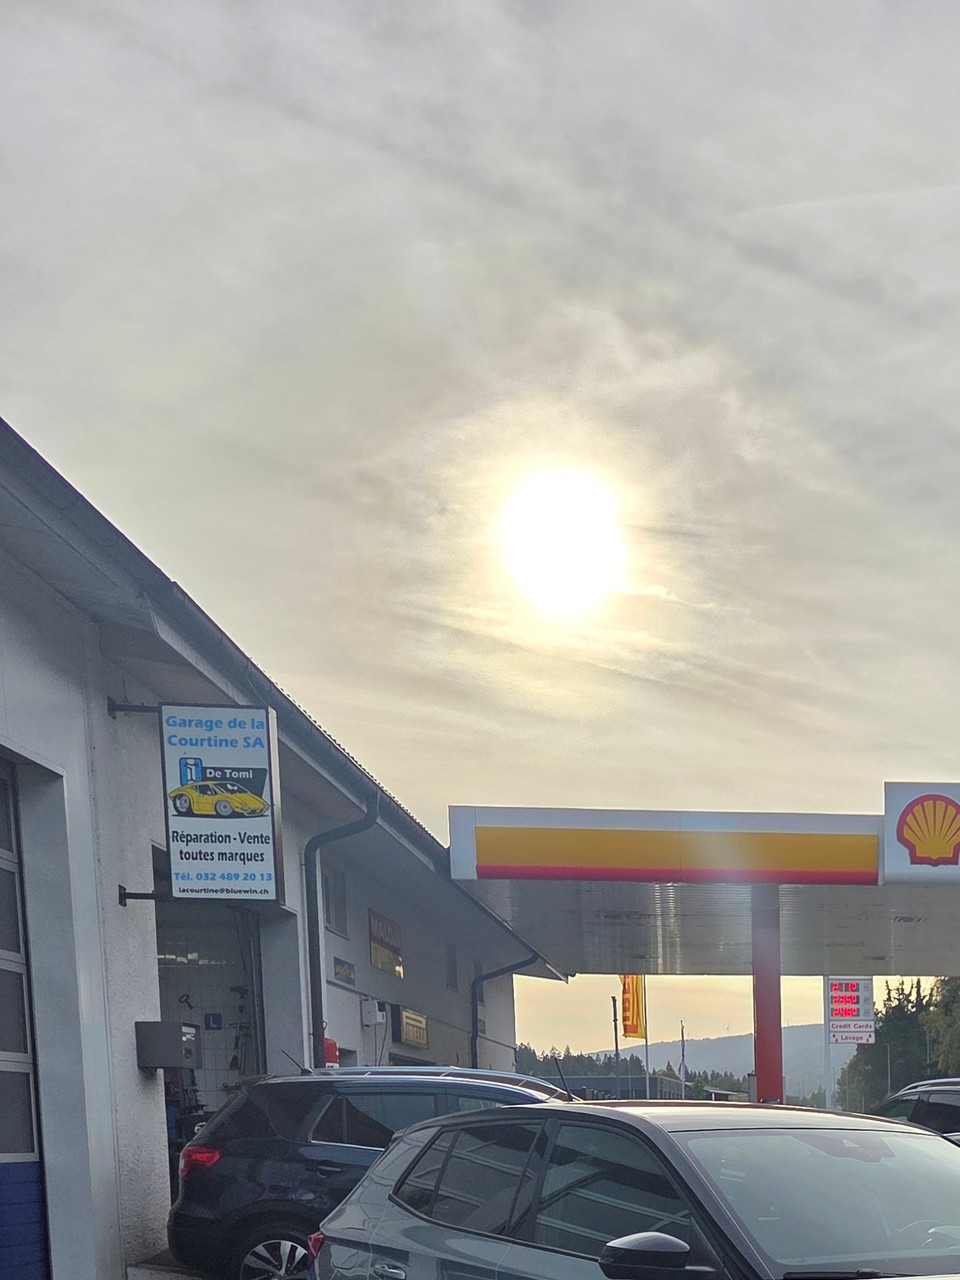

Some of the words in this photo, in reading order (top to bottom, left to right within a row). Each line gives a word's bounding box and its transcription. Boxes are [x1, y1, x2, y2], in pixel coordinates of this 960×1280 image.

[165, 715, 224, 732] Garage
[227, 717, 247, 729] de
[250, 718, 265, 730] la
[167, 734, 239, 748] Courtine
[242, 736, 265, 748] SA
[206, 769, 222, 778] De
[224, 769, 253, 778] Tomi
[171, 830, 232, 847] Réparation
[238, 831, 271, 845] Vente
[179, 849, 215, 861] toutes
[217, 851, 265, 866] marques
[173, 872, 193, 881] Tél.
[195, 872, 217, 881] 032
[219, 872, 240, 881] 489
[242, 872, 256, 881] 20
[259, 872, 273, 881] 13
[178, 887, 269, 895] lacourtine@bluewin.ch
